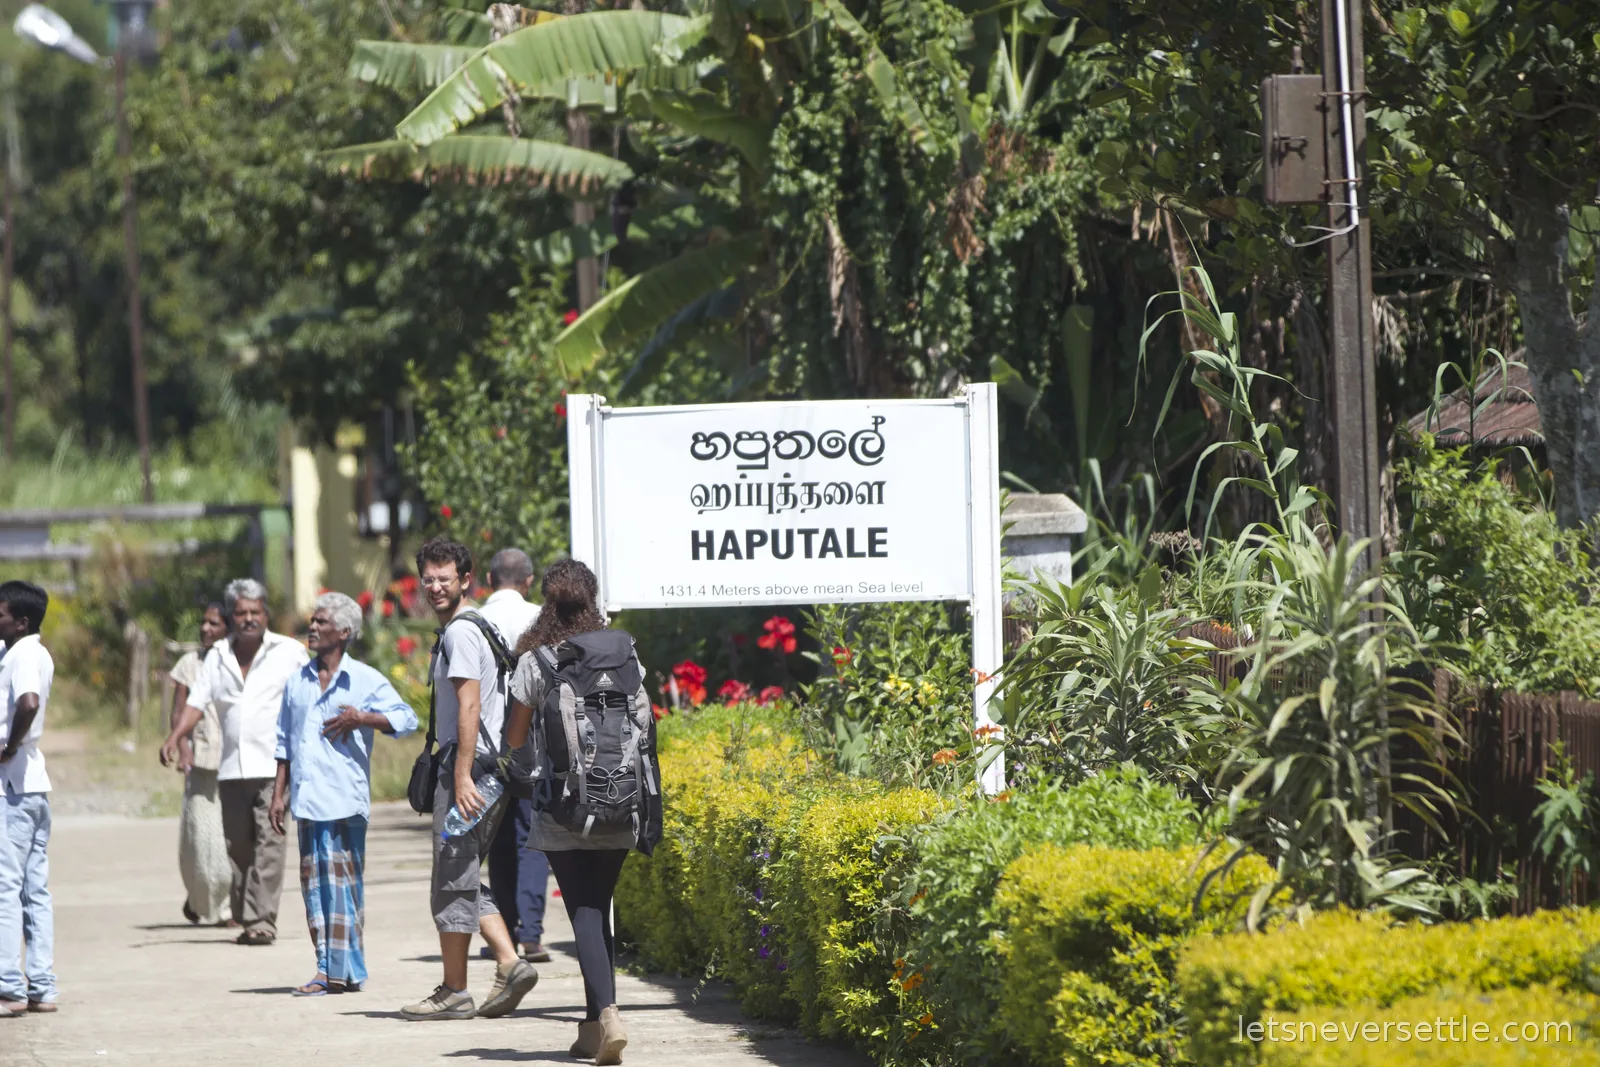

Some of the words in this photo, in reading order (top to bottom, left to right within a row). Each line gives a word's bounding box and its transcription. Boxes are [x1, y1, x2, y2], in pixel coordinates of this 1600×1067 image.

[690, 415, 887, 471] හපුතලේ
[690, 472, 887, 515] ஹப்புத்தளை
[691, 526, 889, 561] HAPUTALE
[660, 585, 707, 597] 1431.4
[711, 584, 761, 596] Meters
[765, 584, 809, 595] above
[813, 585, 853, 594] mean
[858, 581, 886, 594] Sea
[890, 581, 924, 593] level
